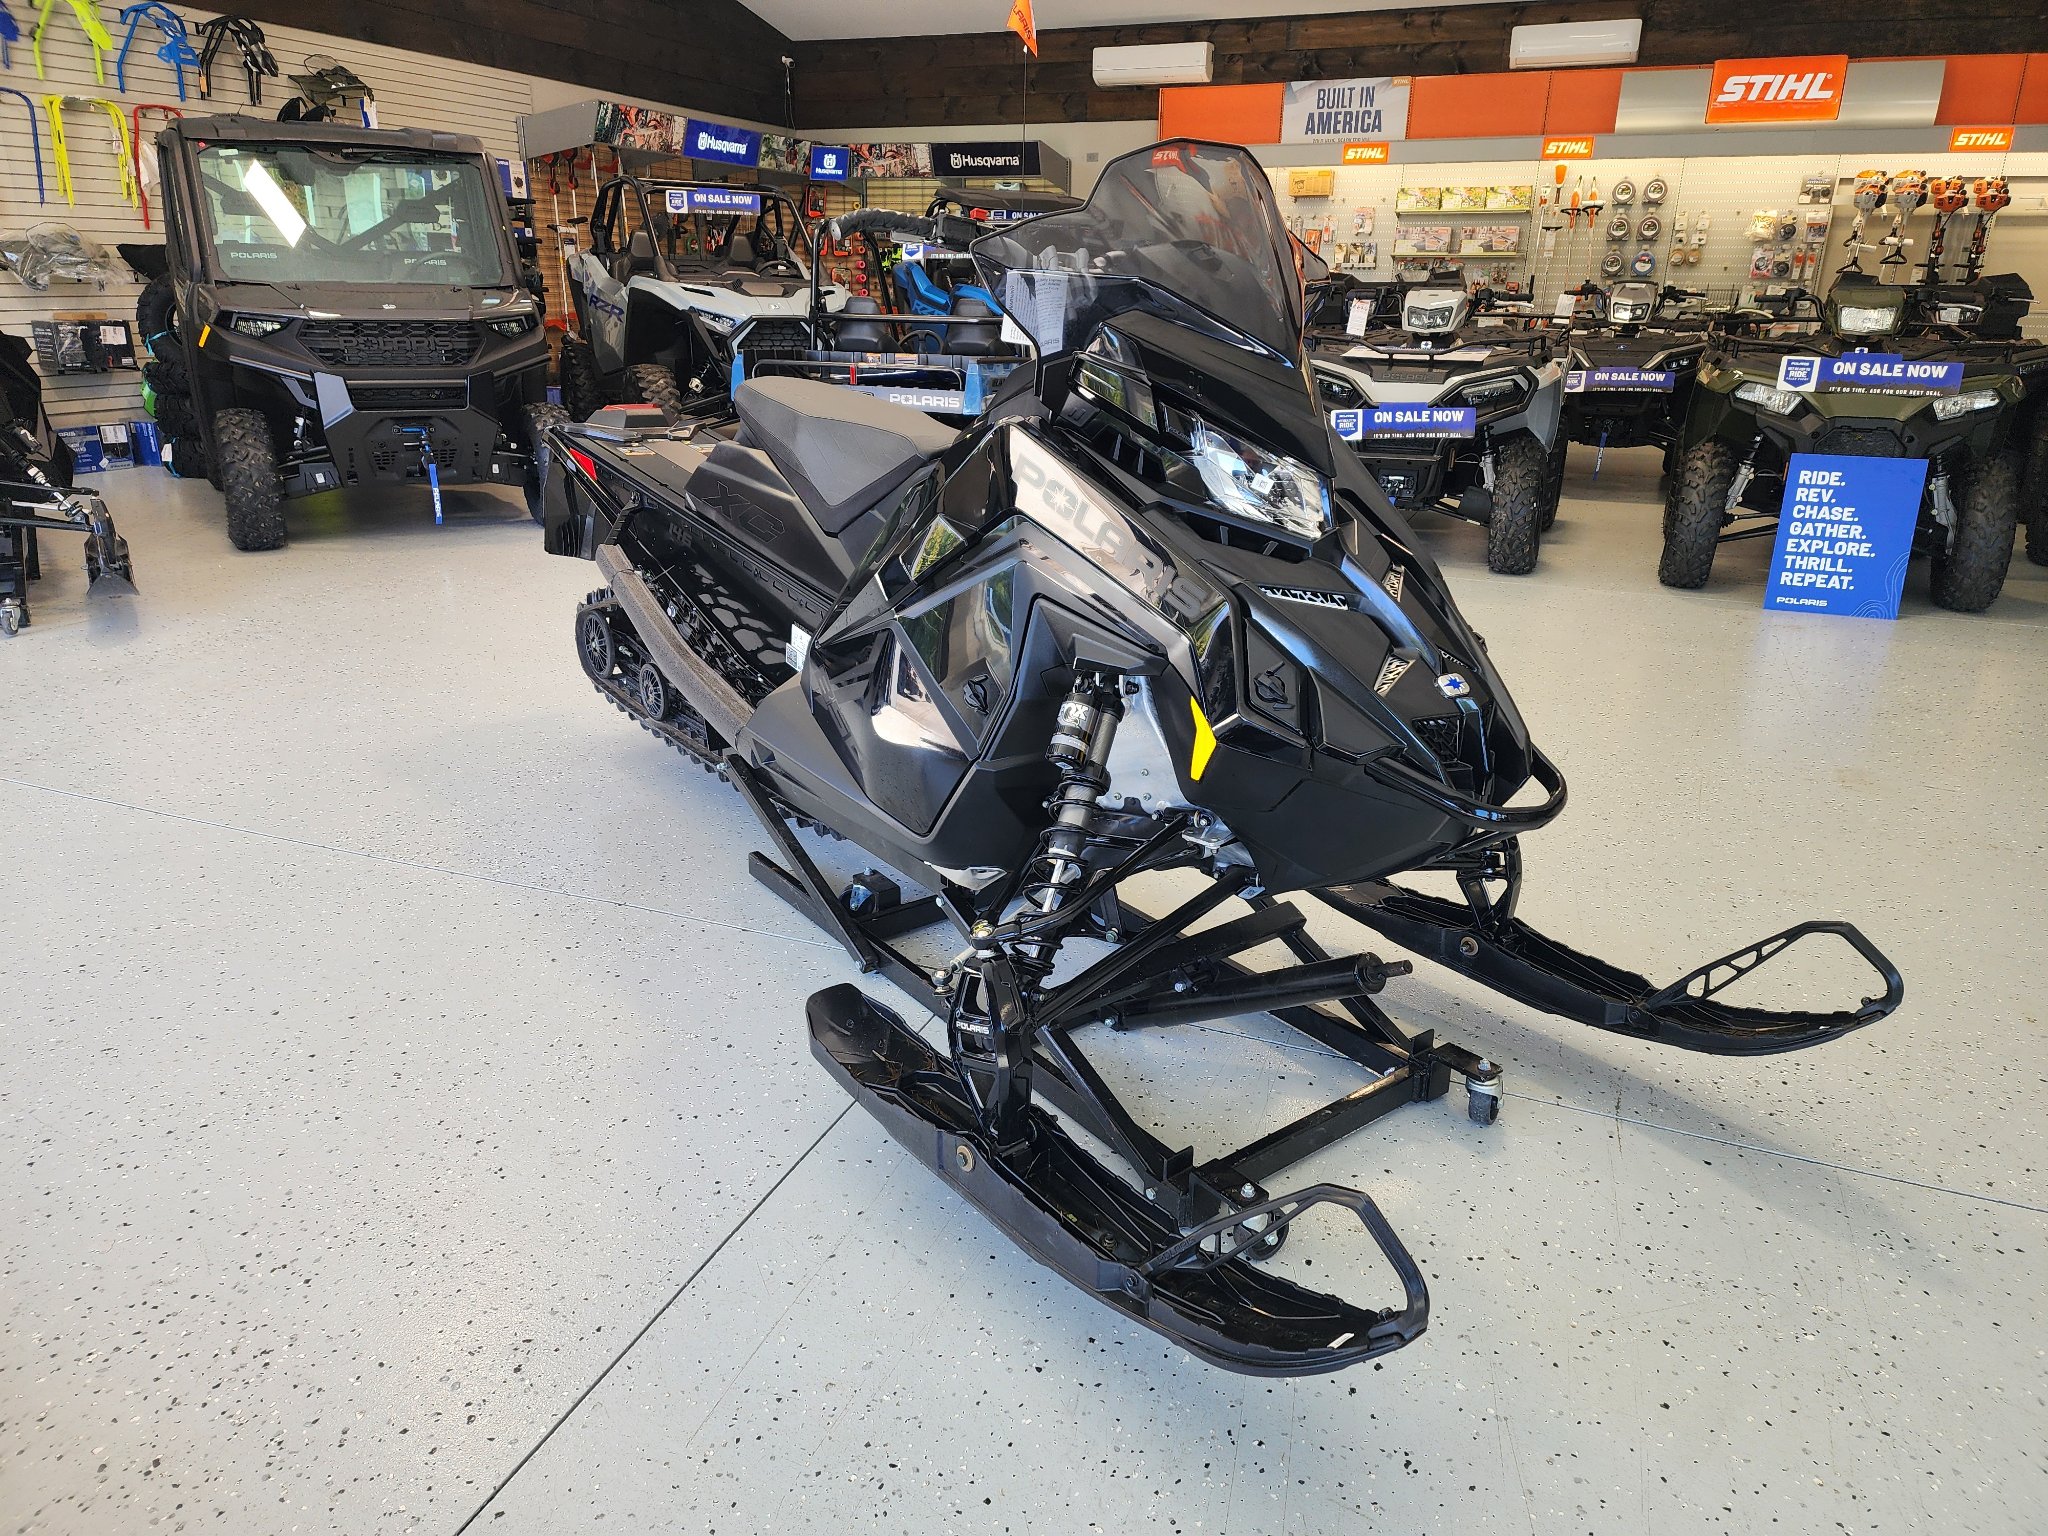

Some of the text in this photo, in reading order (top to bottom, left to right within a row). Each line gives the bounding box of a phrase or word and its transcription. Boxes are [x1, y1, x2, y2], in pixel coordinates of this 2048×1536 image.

[1716, 73, 1833, 102] STIHL
[1317, 86, 1376, 109] BUILT IN
[1304, 110, 1382, 135] AMERICA
[708, 135, 748, 155] Husqvarna
[1954, 133, 2006, 146] STIHL
[1345, 148, 1385, 160] STIHL
[1545, 141, 1589, 154] STIHL
[962, 154, 1020, 168] Husqvarna
[815, 167, 843, 175] Husqvarna
[694, 193, 753, 204] ON SALE NOW
[1011, 211, 1022, 219] ON
[404, 258, 447, 266] PARIS
[588, 294, 625, 323] RZR
[338, 336, 453, 351] POLARIS
[1382, 373, 1438, 381] POLARIS
[1594, 373, 1666, 382] ON SALE NOW
[1789, 370, 1808, 378] RIDE
[1833, 362, 1949, 378] ON SALE NOW
[888, 393, 960, 408] POLARIS
[1374, 410, 1465, 423] ON SALE NOW
[1798, 470, 1846, 486] RIDE.
[1795, 487, 1836, 503] REV.
[701, 480, 785, 543] XC
[1792, 504, 1859, 522] CHASE.
[668, 521, 693, 548] 146
[1011, 452, 1207, 624] POLARIS
[1789, 521, 1867, 540] GATHER.
[1786, 538, 1876, 558] EXPLORE.
[1784, 555, 1853, 573] THRILL.
[1780, 571, 1855, 590] REPEAT.
[1776, 596, 1828, 607] POLARIS
[955, 1020, 990, 1035] POLARIS
